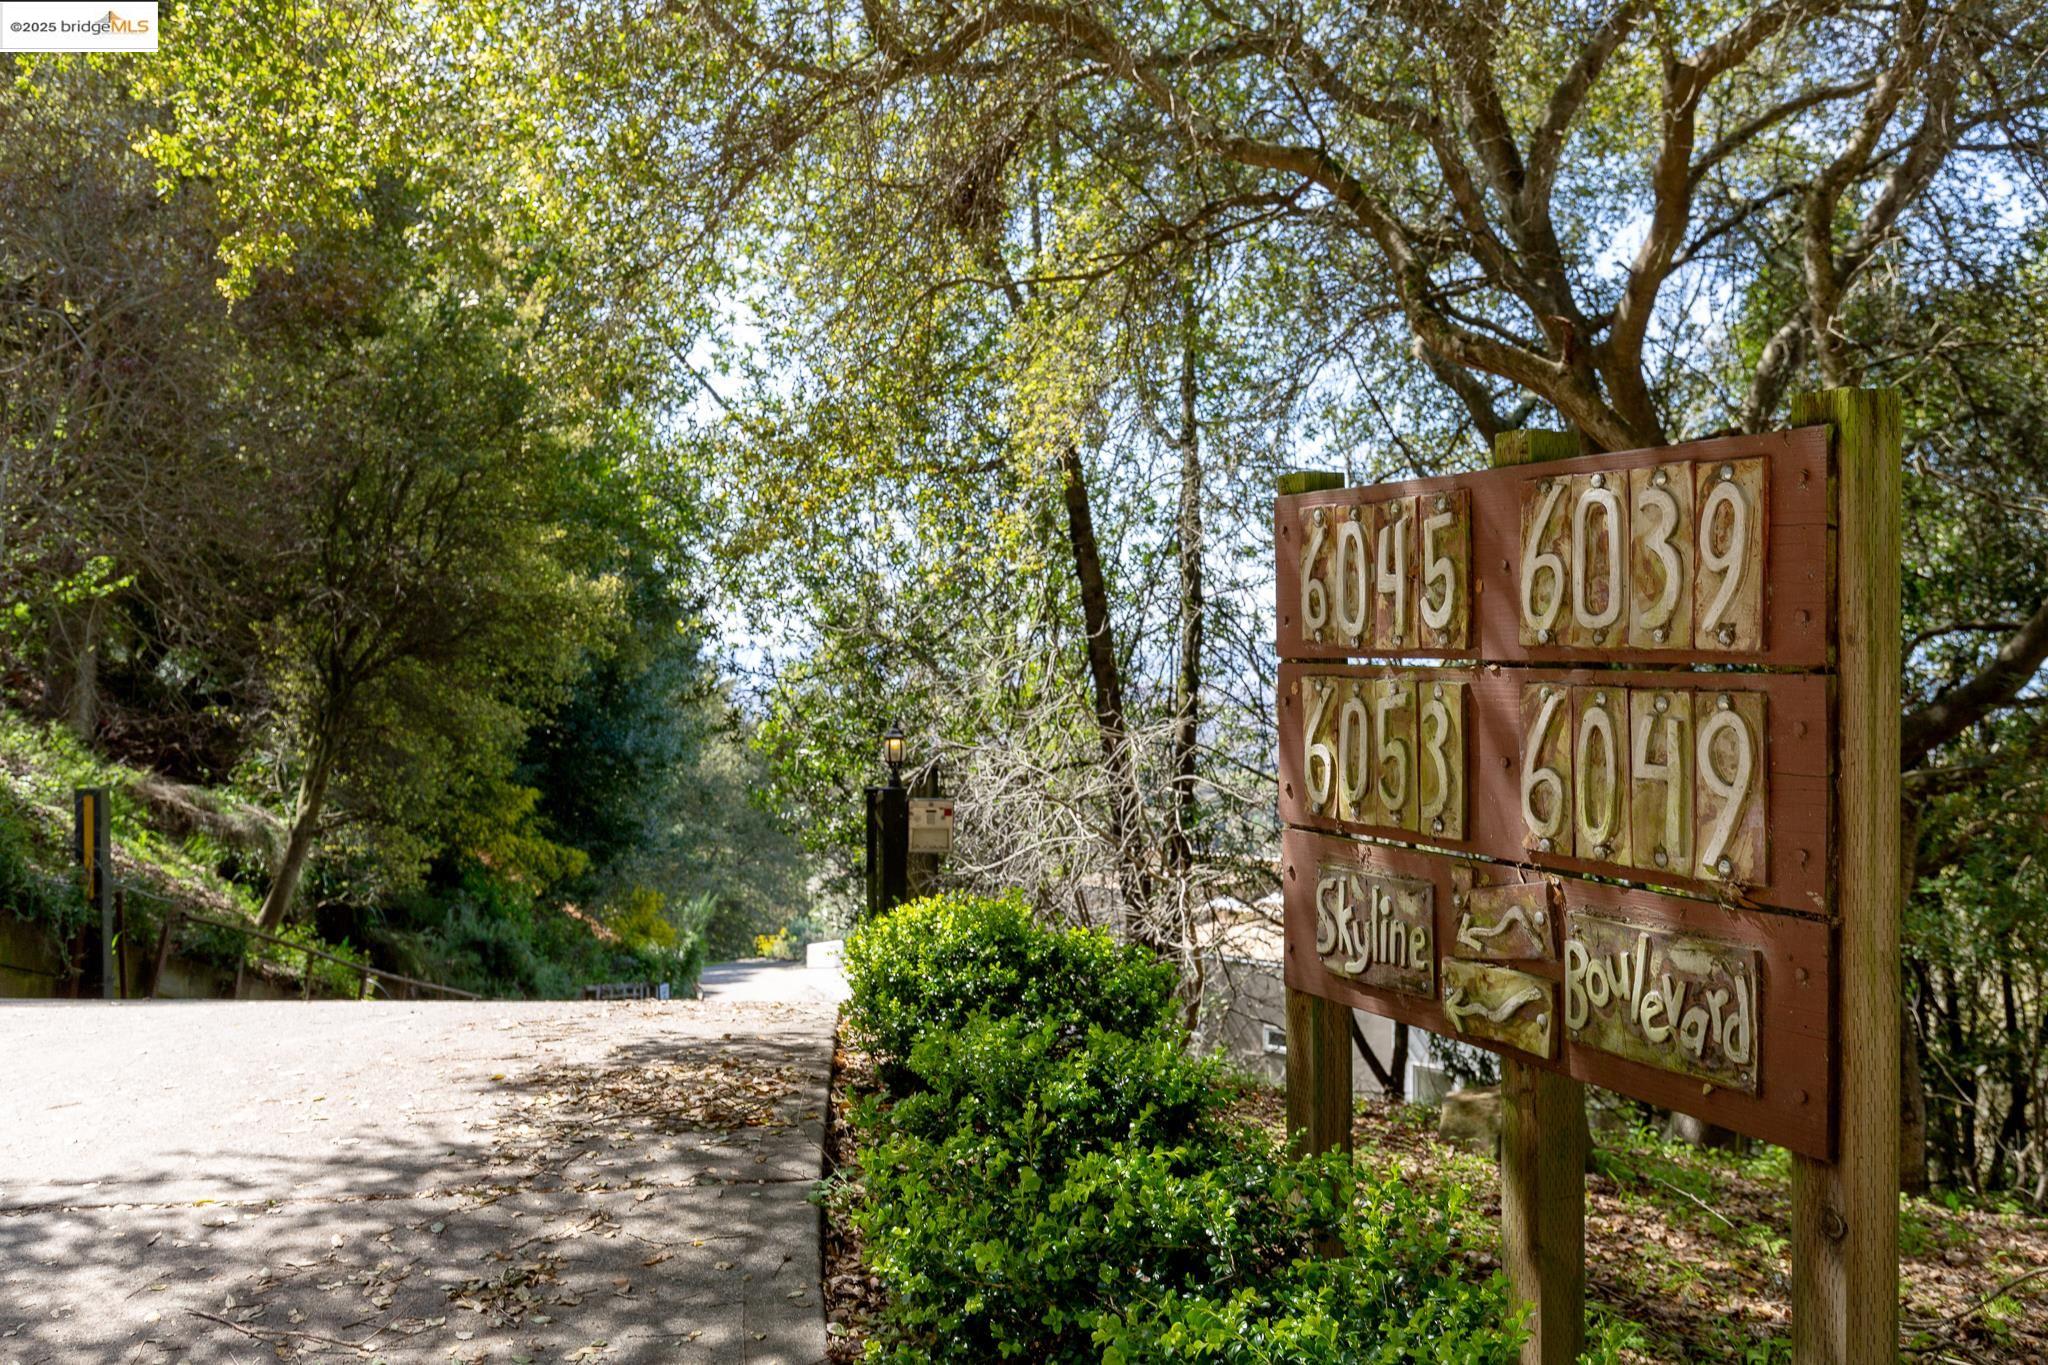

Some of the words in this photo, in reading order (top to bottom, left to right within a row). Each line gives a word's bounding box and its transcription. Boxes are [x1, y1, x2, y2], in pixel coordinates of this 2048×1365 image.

[1301, 511, 1456, 637] 6045
[1521, 481, 1752, 631] 6039
[1303, 686, 1450, 820] 6053
[1521, 685, 1754, 868] 6049
[1315, 875, 1429, 975] Skyline
[1564, 931, 1753, 1066] Boulevard
